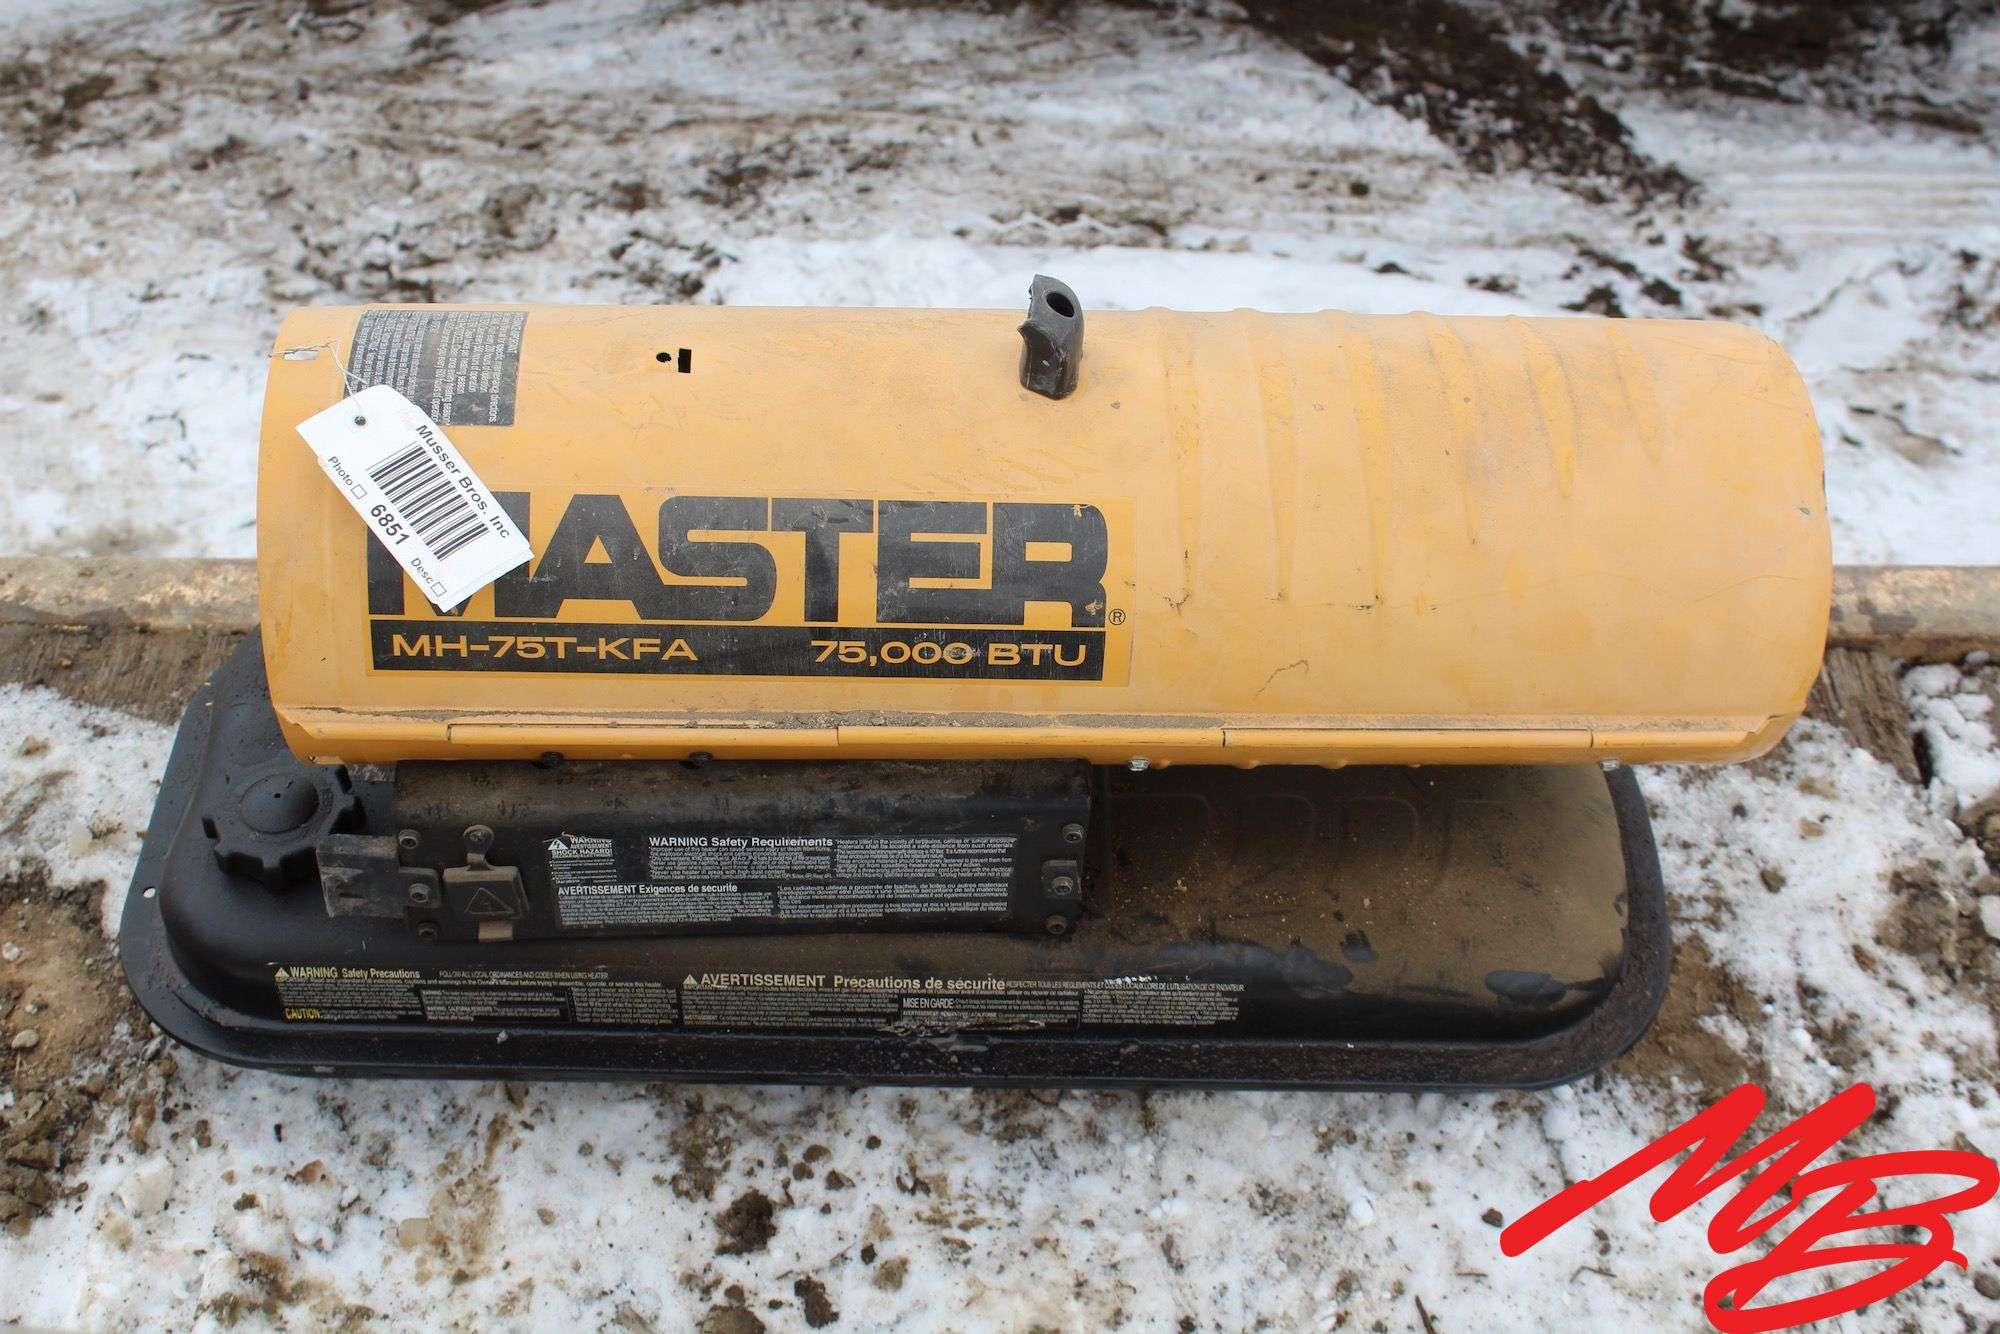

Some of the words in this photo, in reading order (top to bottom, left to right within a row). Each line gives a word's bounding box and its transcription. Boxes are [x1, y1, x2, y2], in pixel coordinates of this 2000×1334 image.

[328, 456, 352, 486] Photo
[416, 425, 460, 475] Musser
[460, 477, 487, 516] Bros.
[490, 516, 510, 538] Inc
[370, 504, 410, 545] 6851
[411, 558, 433, 584] Desc
[392, 634, 698, 662] MH-75T-KFA
[811, 640, 973, 668] 75,000
[987, 642, 1087, 668] BTU
[650, 837, 708, 846] WARNING
[711, 837, 748, 848] Safety
[751, 837, 833, 848] Requirements
[558, 885, 637, 896] AVERTISSEMENT
[640, 884, 686, 894] Exigences
[688, 884, 700, 892] de
[290, 967, 338, 978] WARNING
[342, 968, 368, 980] Safety
[370, 968, 420, 978] Precautions
[700, 973, 826, 986] AVERTISSEMENT
[925, 976, 943, 989] de
[903, 998, 919, 1008] MISE
[920, 998, 930, 1008] EN
